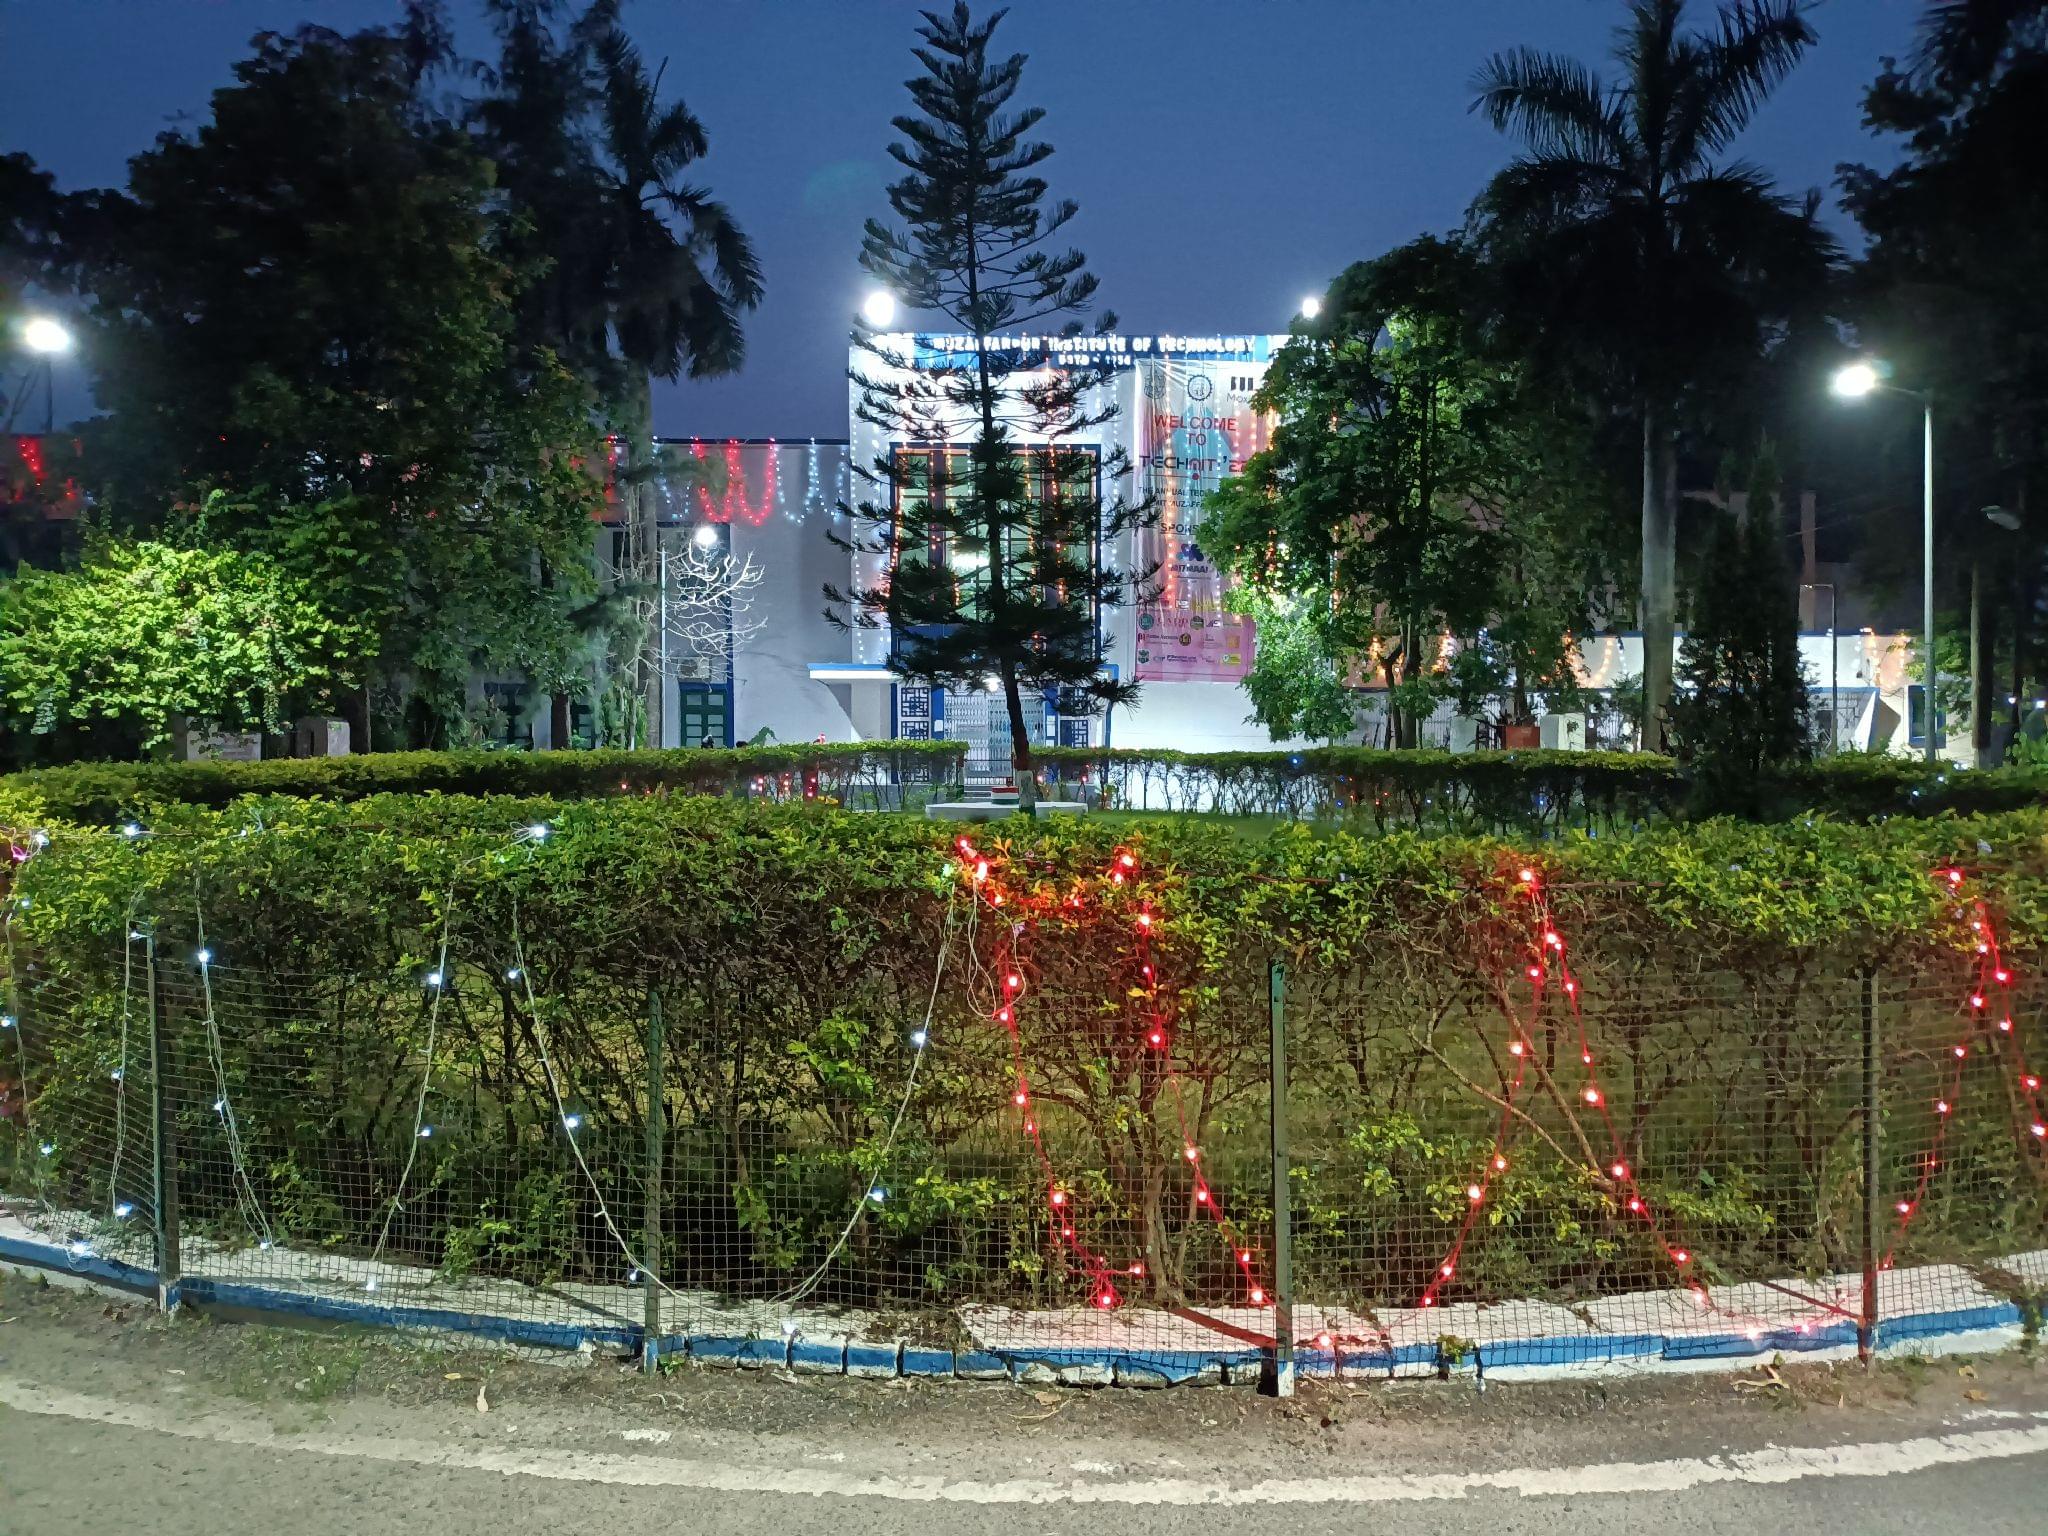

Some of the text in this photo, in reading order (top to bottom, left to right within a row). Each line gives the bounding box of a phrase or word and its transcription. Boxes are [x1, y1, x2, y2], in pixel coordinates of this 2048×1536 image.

[1049, 336, 1126, 352] INSTITUTE
[1133, 337, 1150, 351] OF
[1157, 336, 1255, 352] TECHNOLOGY
[1154, 414, 1237, 431] WELCOME
[1187, 433, 1206, 446] TO
[1190, 489, 1205, 497] TEC
[1160, 522, 1200, 533] SPONS
